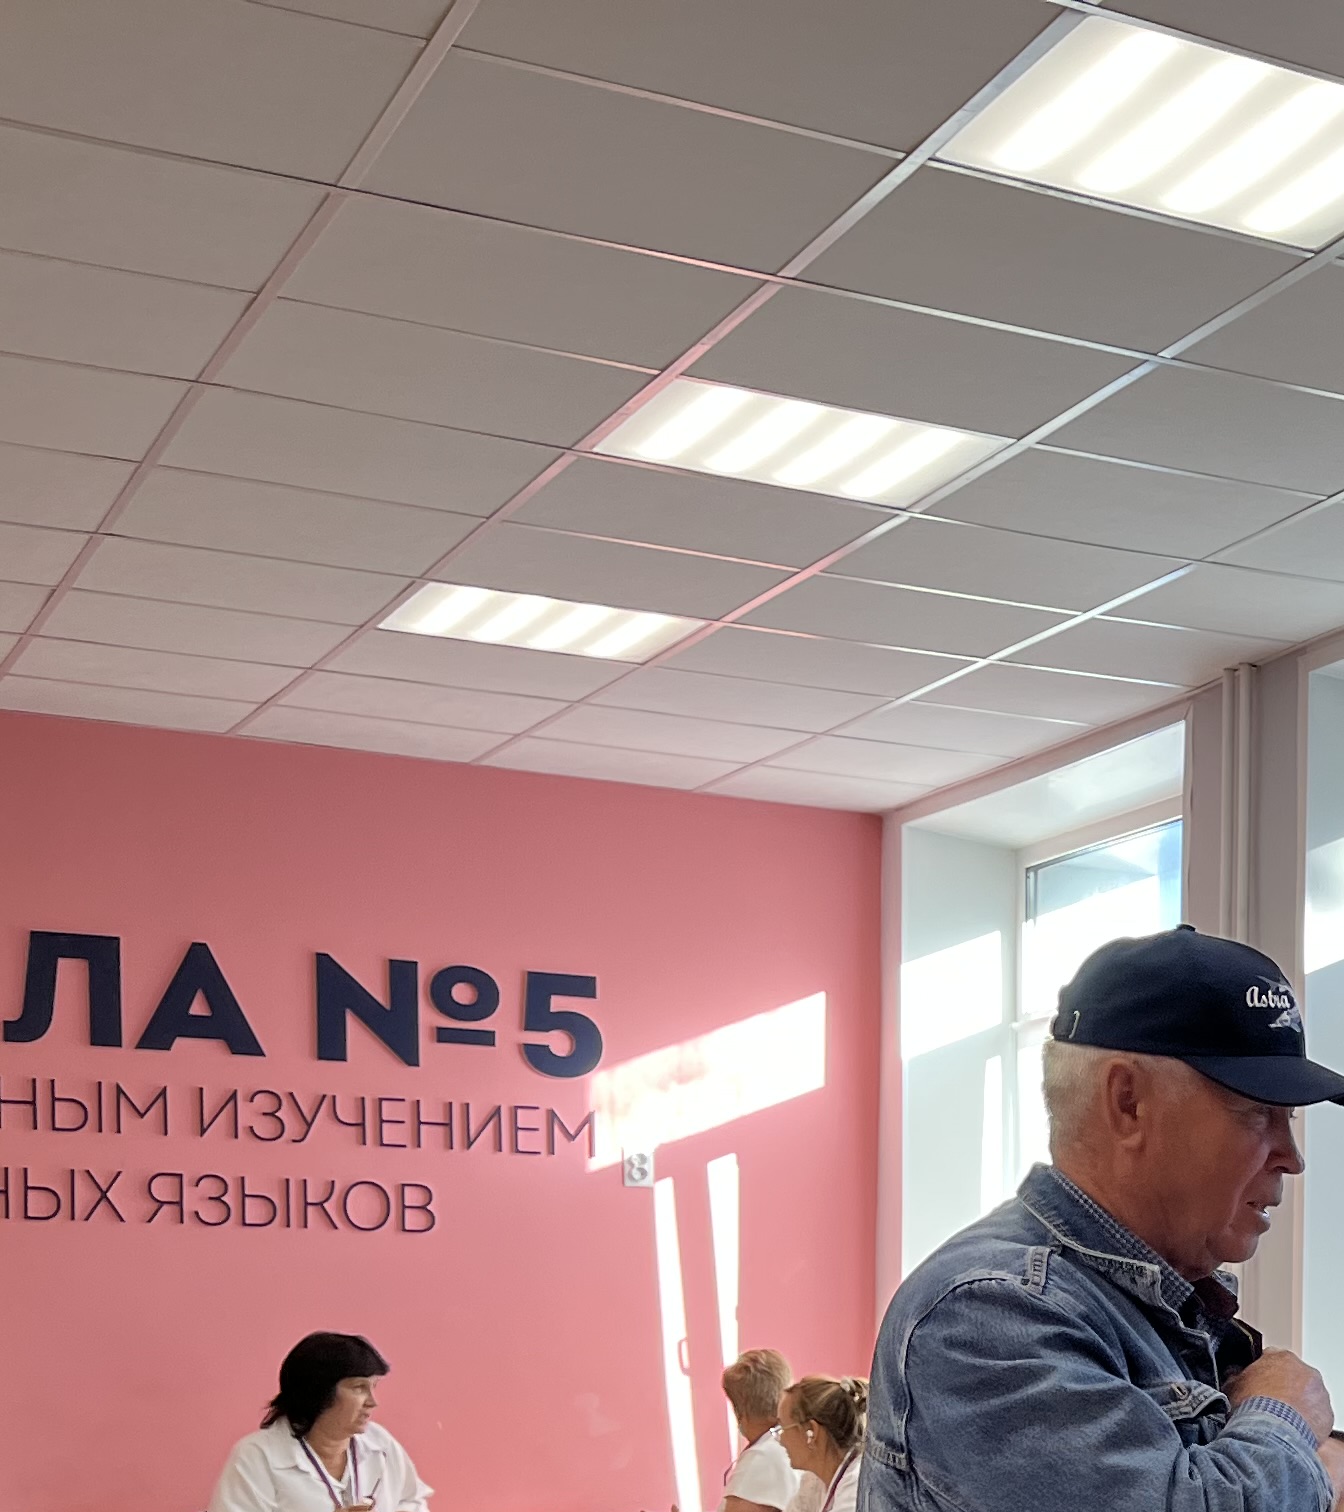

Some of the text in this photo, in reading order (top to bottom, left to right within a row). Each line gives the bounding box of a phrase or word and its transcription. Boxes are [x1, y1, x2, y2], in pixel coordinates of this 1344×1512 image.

[2, 930, 266, 1059] ЛА
[1245, 985, 1292, 1009] Astra
[198, 1086, 598, 1159] ИЗУЧЕНИЕМ
[146, 1173, 437, 1234] ЯЗЫКОВ
